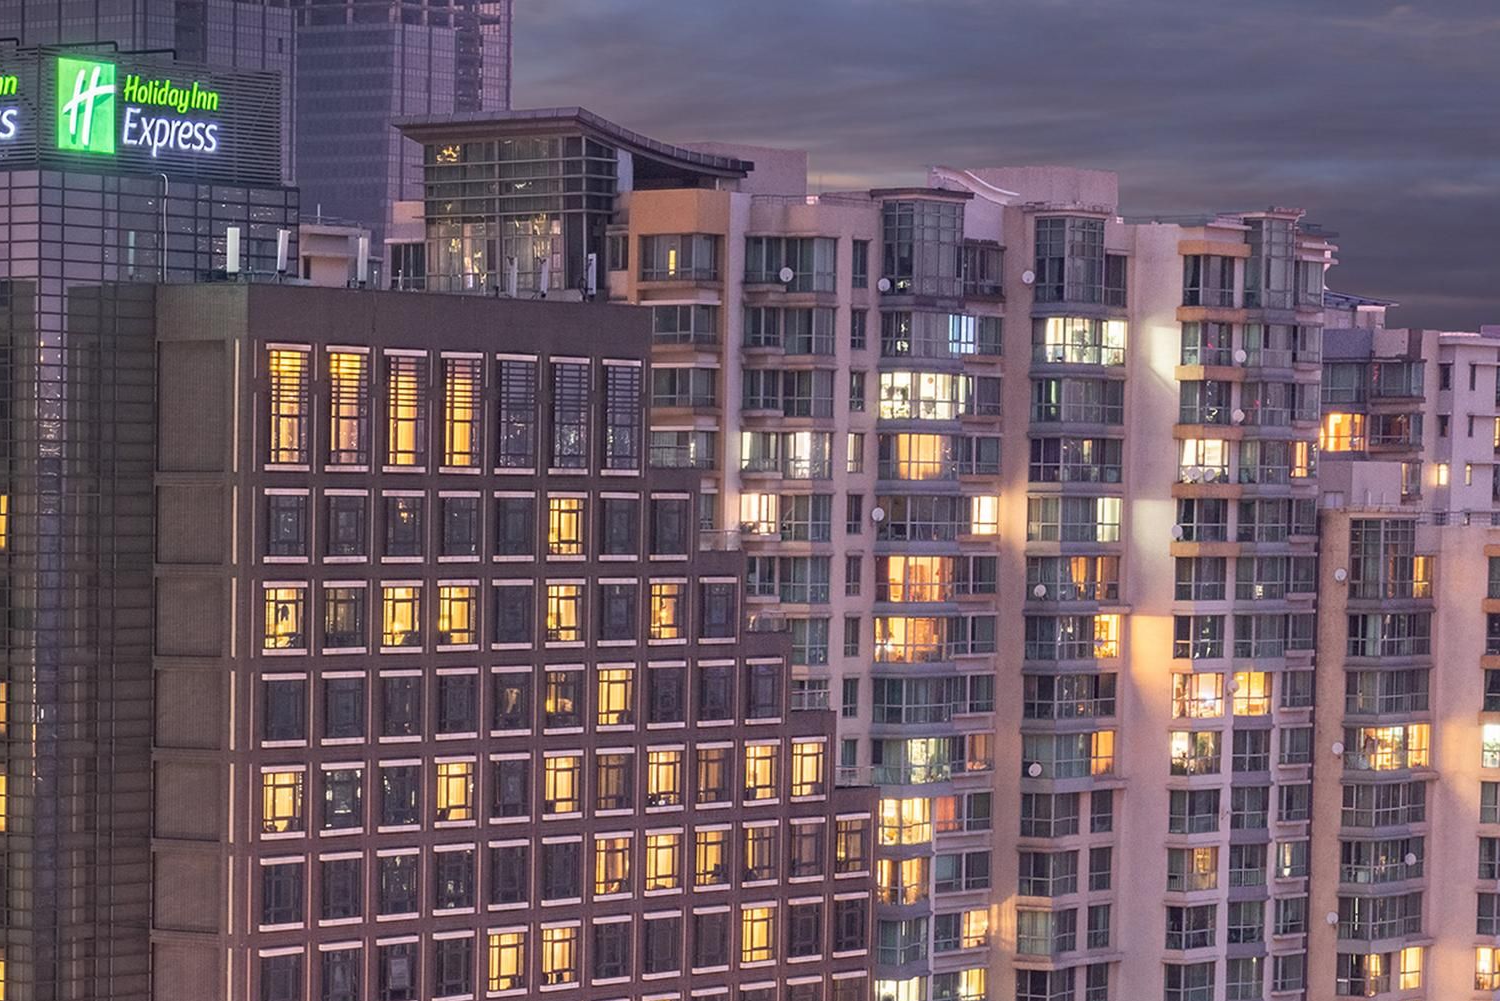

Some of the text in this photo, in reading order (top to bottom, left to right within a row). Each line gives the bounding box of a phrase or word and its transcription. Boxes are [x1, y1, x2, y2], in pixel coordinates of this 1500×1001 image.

[123, 75, 219, 113] Holiday Inn
[123, 108, 219, 157] Express
